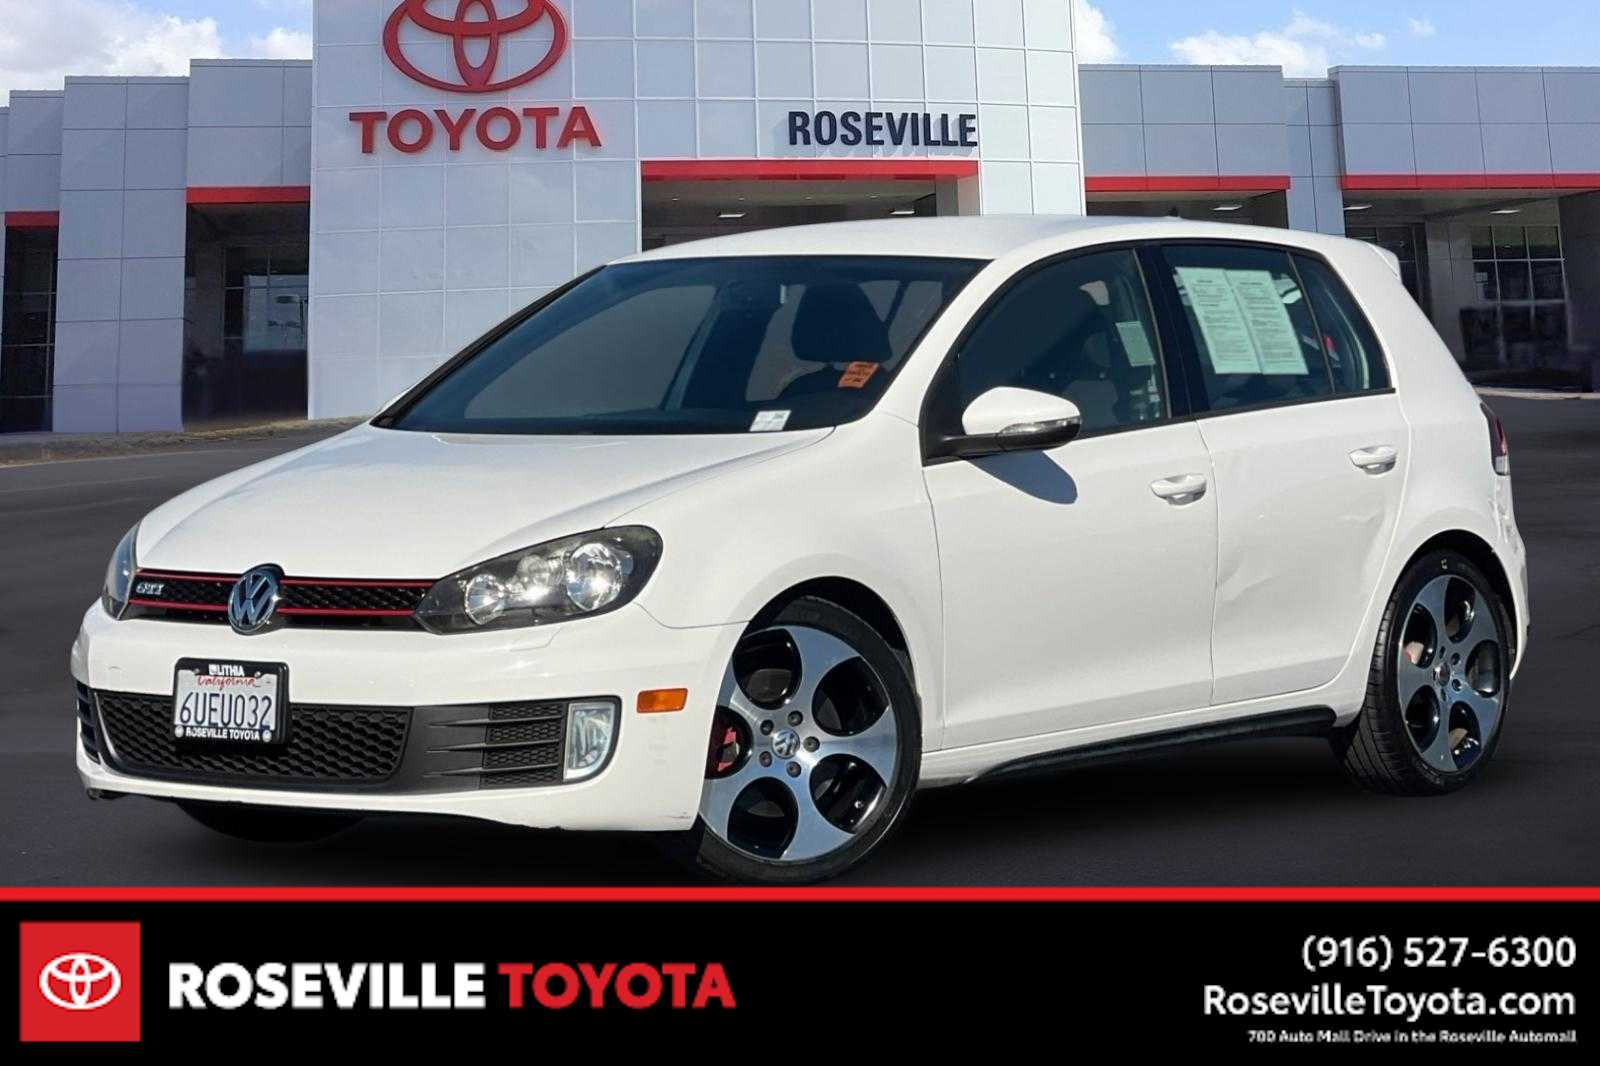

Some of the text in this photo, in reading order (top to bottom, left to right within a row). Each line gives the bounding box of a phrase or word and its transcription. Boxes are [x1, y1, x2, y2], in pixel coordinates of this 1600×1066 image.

[349, 106, 603, 154] TOYOTA
[788, 111, 978, 147] ROSEVILLE
[135, 582, 165, 595] GTI
[216, 664, 245, 677] LITHIA
[196, 675, 260, 690] California
[180, 691, 272, 730] 6UEU032
[186, 726, 260, 741] ROSEVILLE TOYOTA
